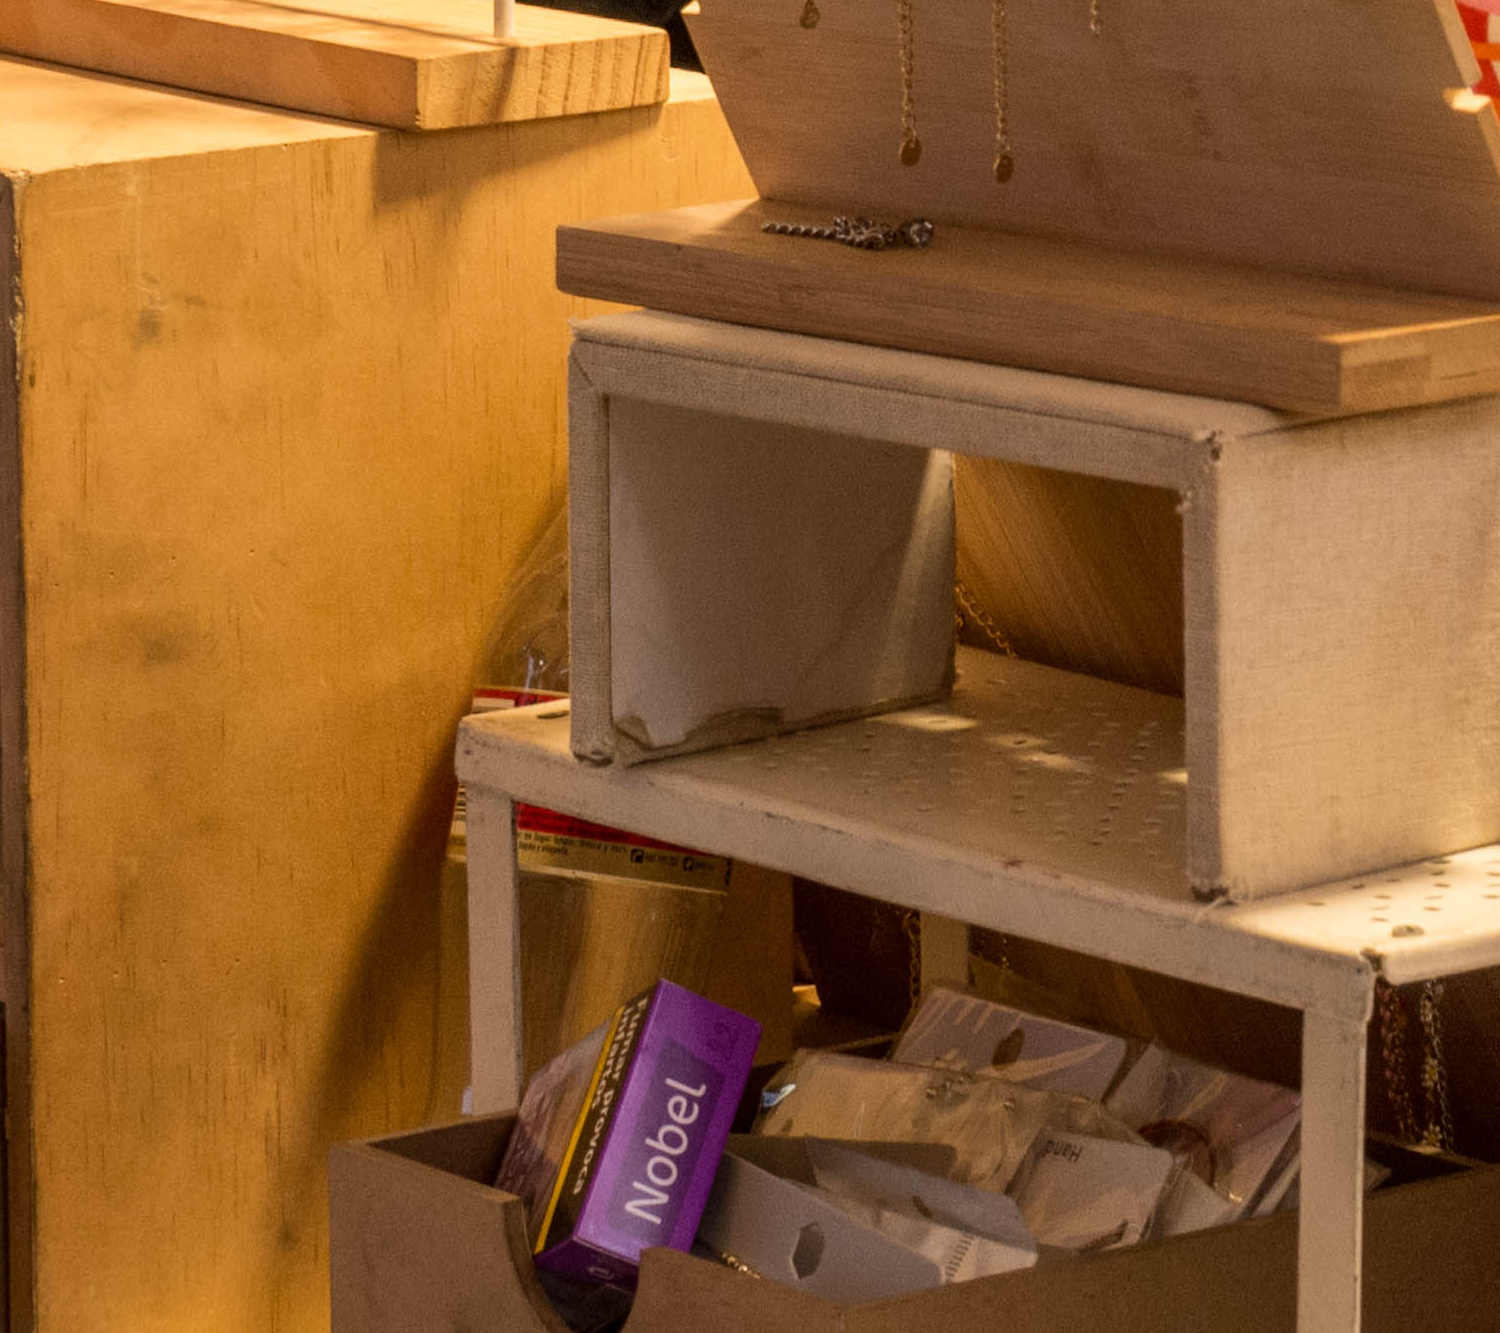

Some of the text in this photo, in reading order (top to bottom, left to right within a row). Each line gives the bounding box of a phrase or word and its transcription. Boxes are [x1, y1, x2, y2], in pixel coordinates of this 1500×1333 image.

[573, 997, 649, 1195] Fumar provoca
[590, 1004, 632, 1109] infartos
[625, 1076, 708, 1226] Nobel
